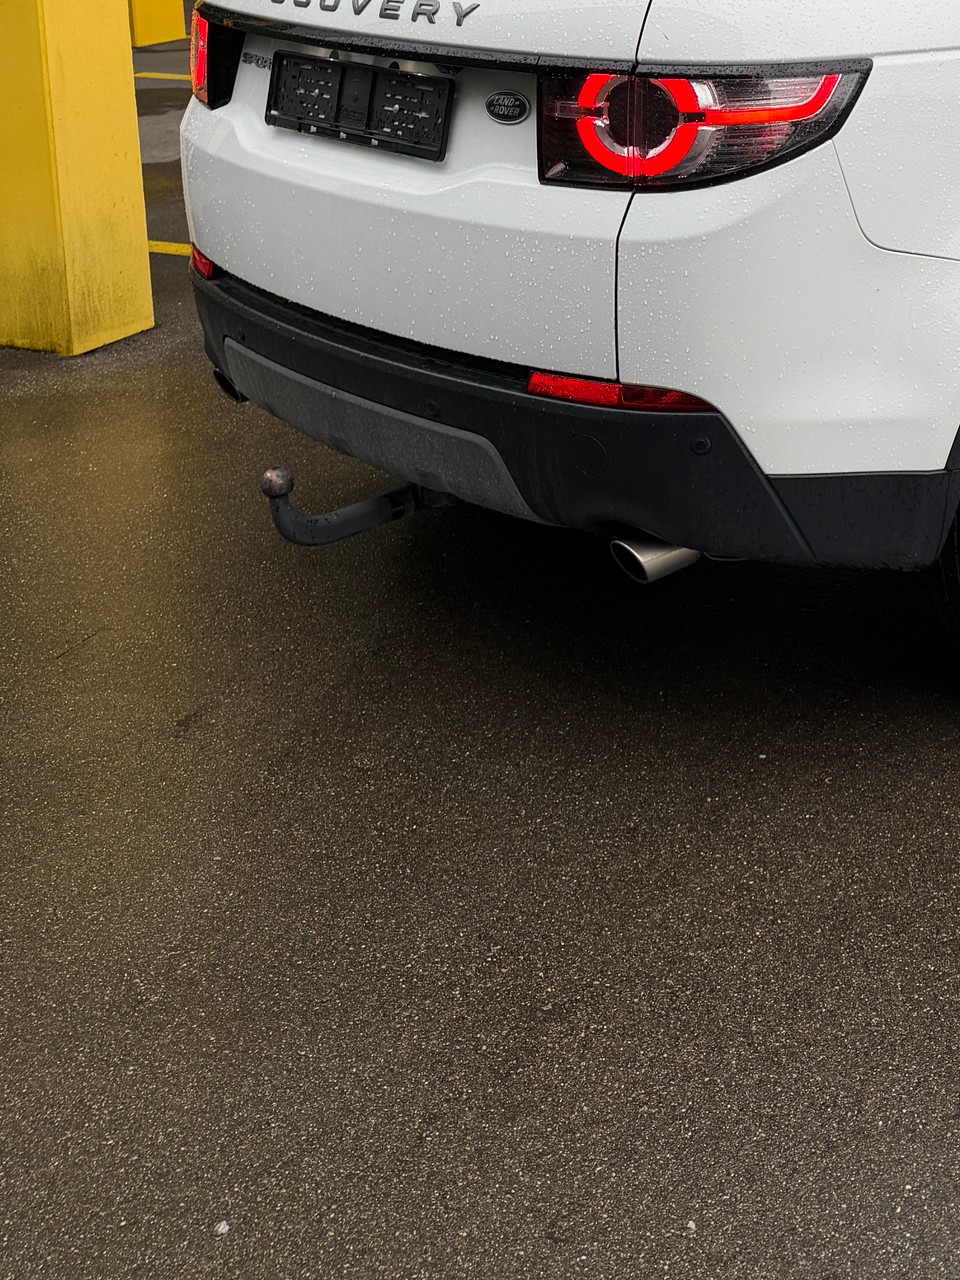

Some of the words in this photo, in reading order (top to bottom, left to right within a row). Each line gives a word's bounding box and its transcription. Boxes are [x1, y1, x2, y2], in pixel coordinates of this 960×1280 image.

[241, 51, 273, 71] SPOR
[493, 95, 516, 107] LAND
[493, 105, 520, 117] ROVER
